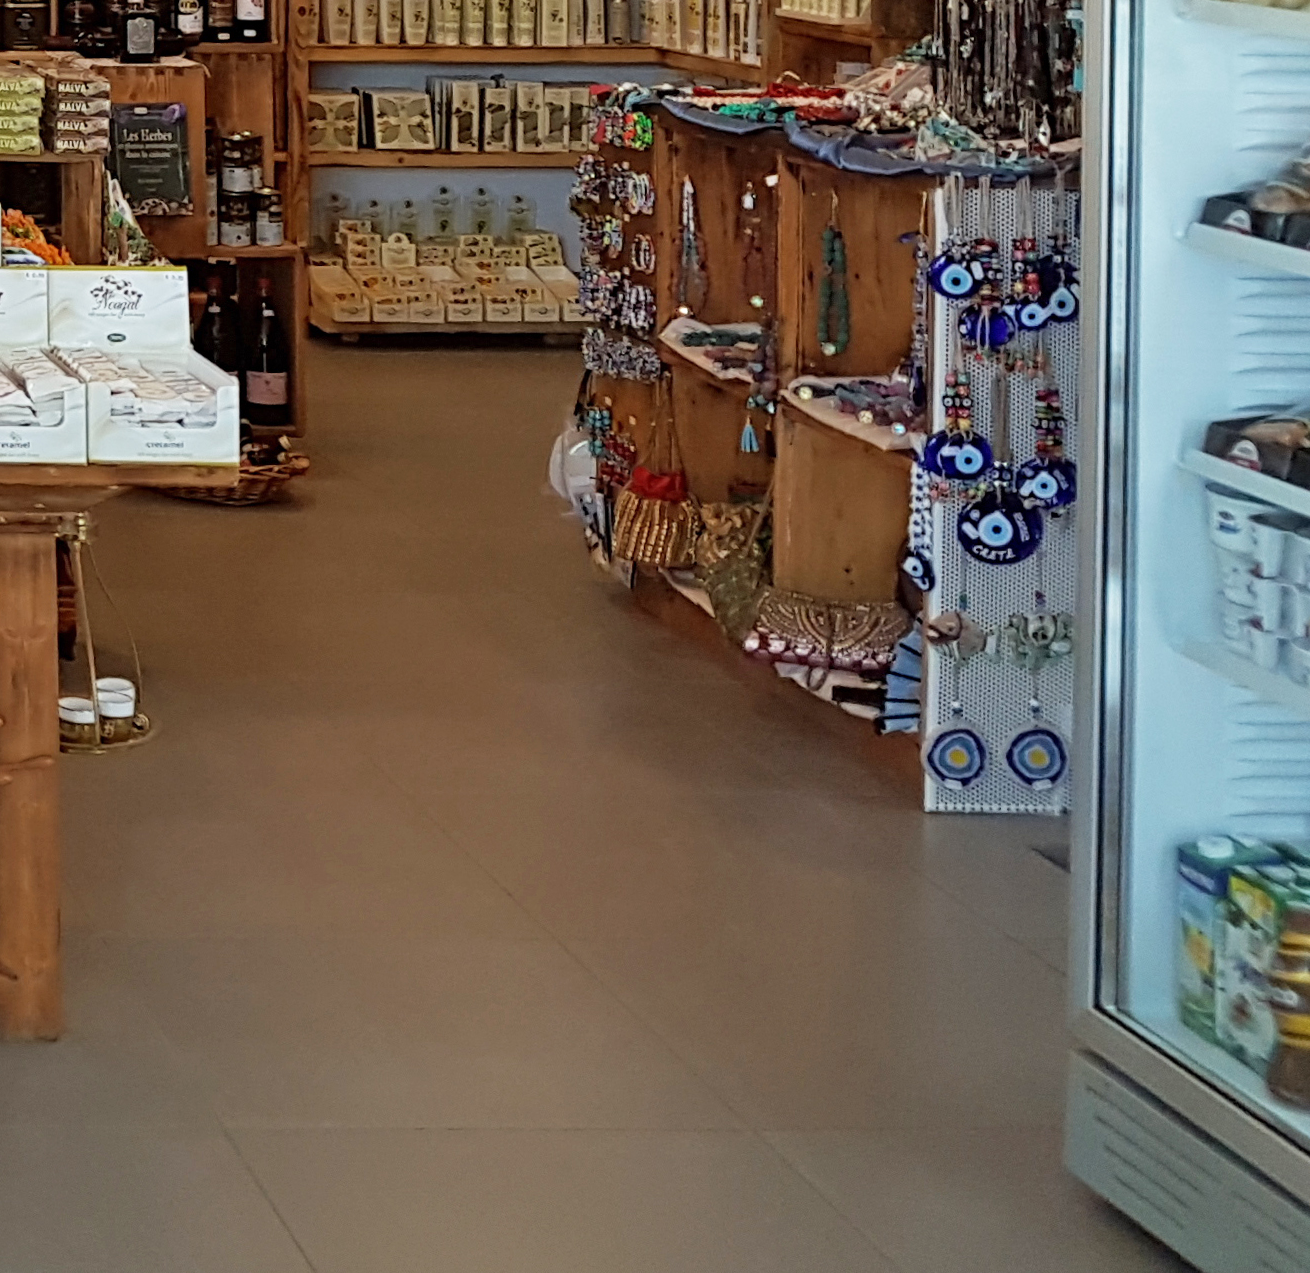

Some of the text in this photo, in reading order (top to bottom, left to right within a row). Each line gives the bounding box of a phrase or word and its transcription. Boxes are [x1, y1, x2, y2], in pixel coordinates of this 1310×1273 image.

[58, 83, 87, 93] HALVA
[60, 102, 88, 112] HALVA
[57, 122, 87, 132] HALVA
[123, 128, 173, 142] Les Herbes
[57, 140, 86, 149] HALVA
[92, 295, 140, 315] Nougat
